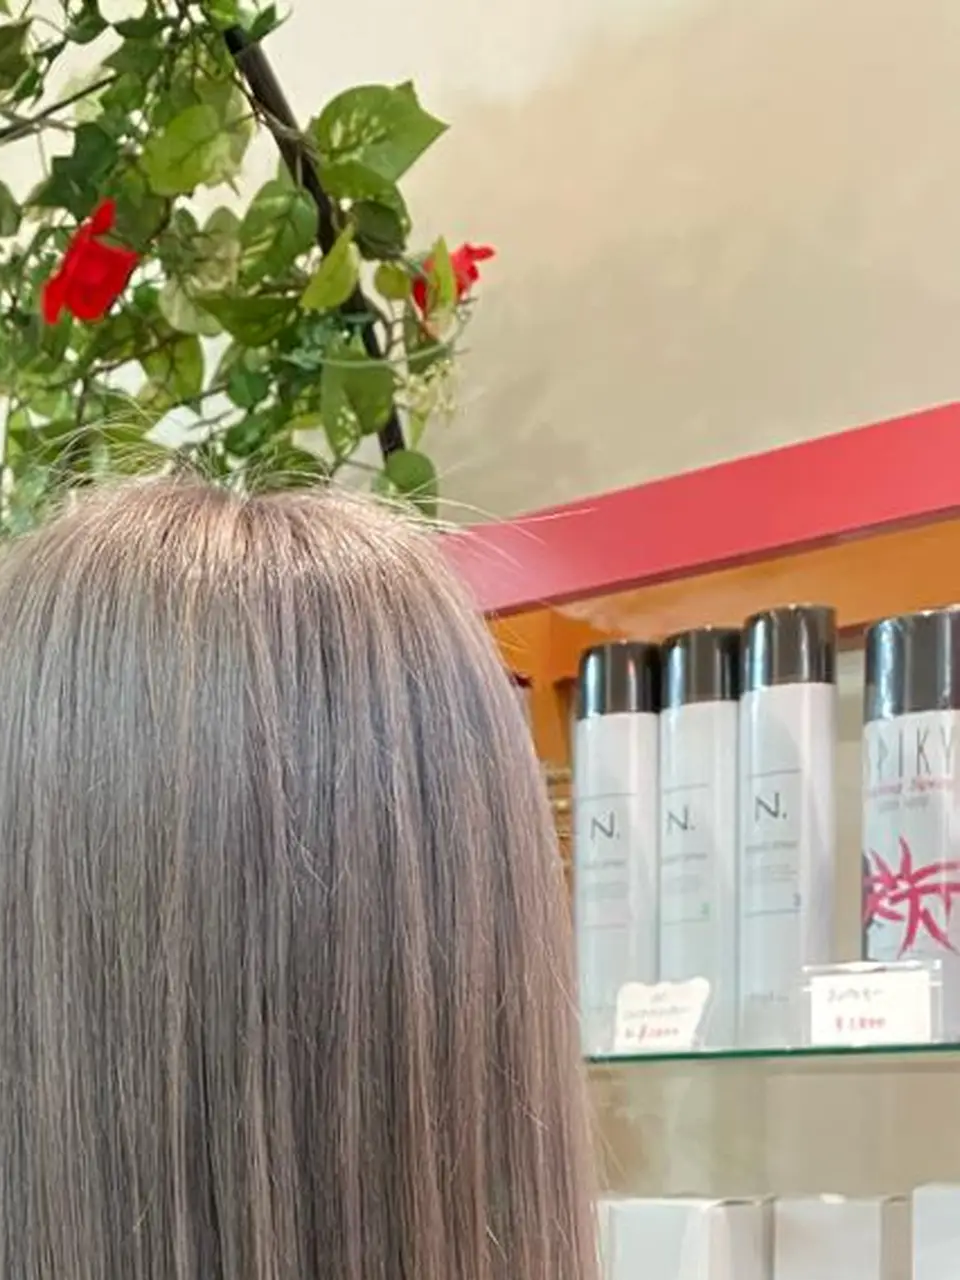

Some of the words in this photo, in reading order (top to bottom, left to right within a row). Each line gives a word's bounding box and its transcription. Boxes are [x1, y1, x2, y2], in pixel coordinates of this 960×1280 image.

[667, 805, 696, 834] N.
[756, 792, 788, 821] N.
[590, 811, 620, 839] N.
